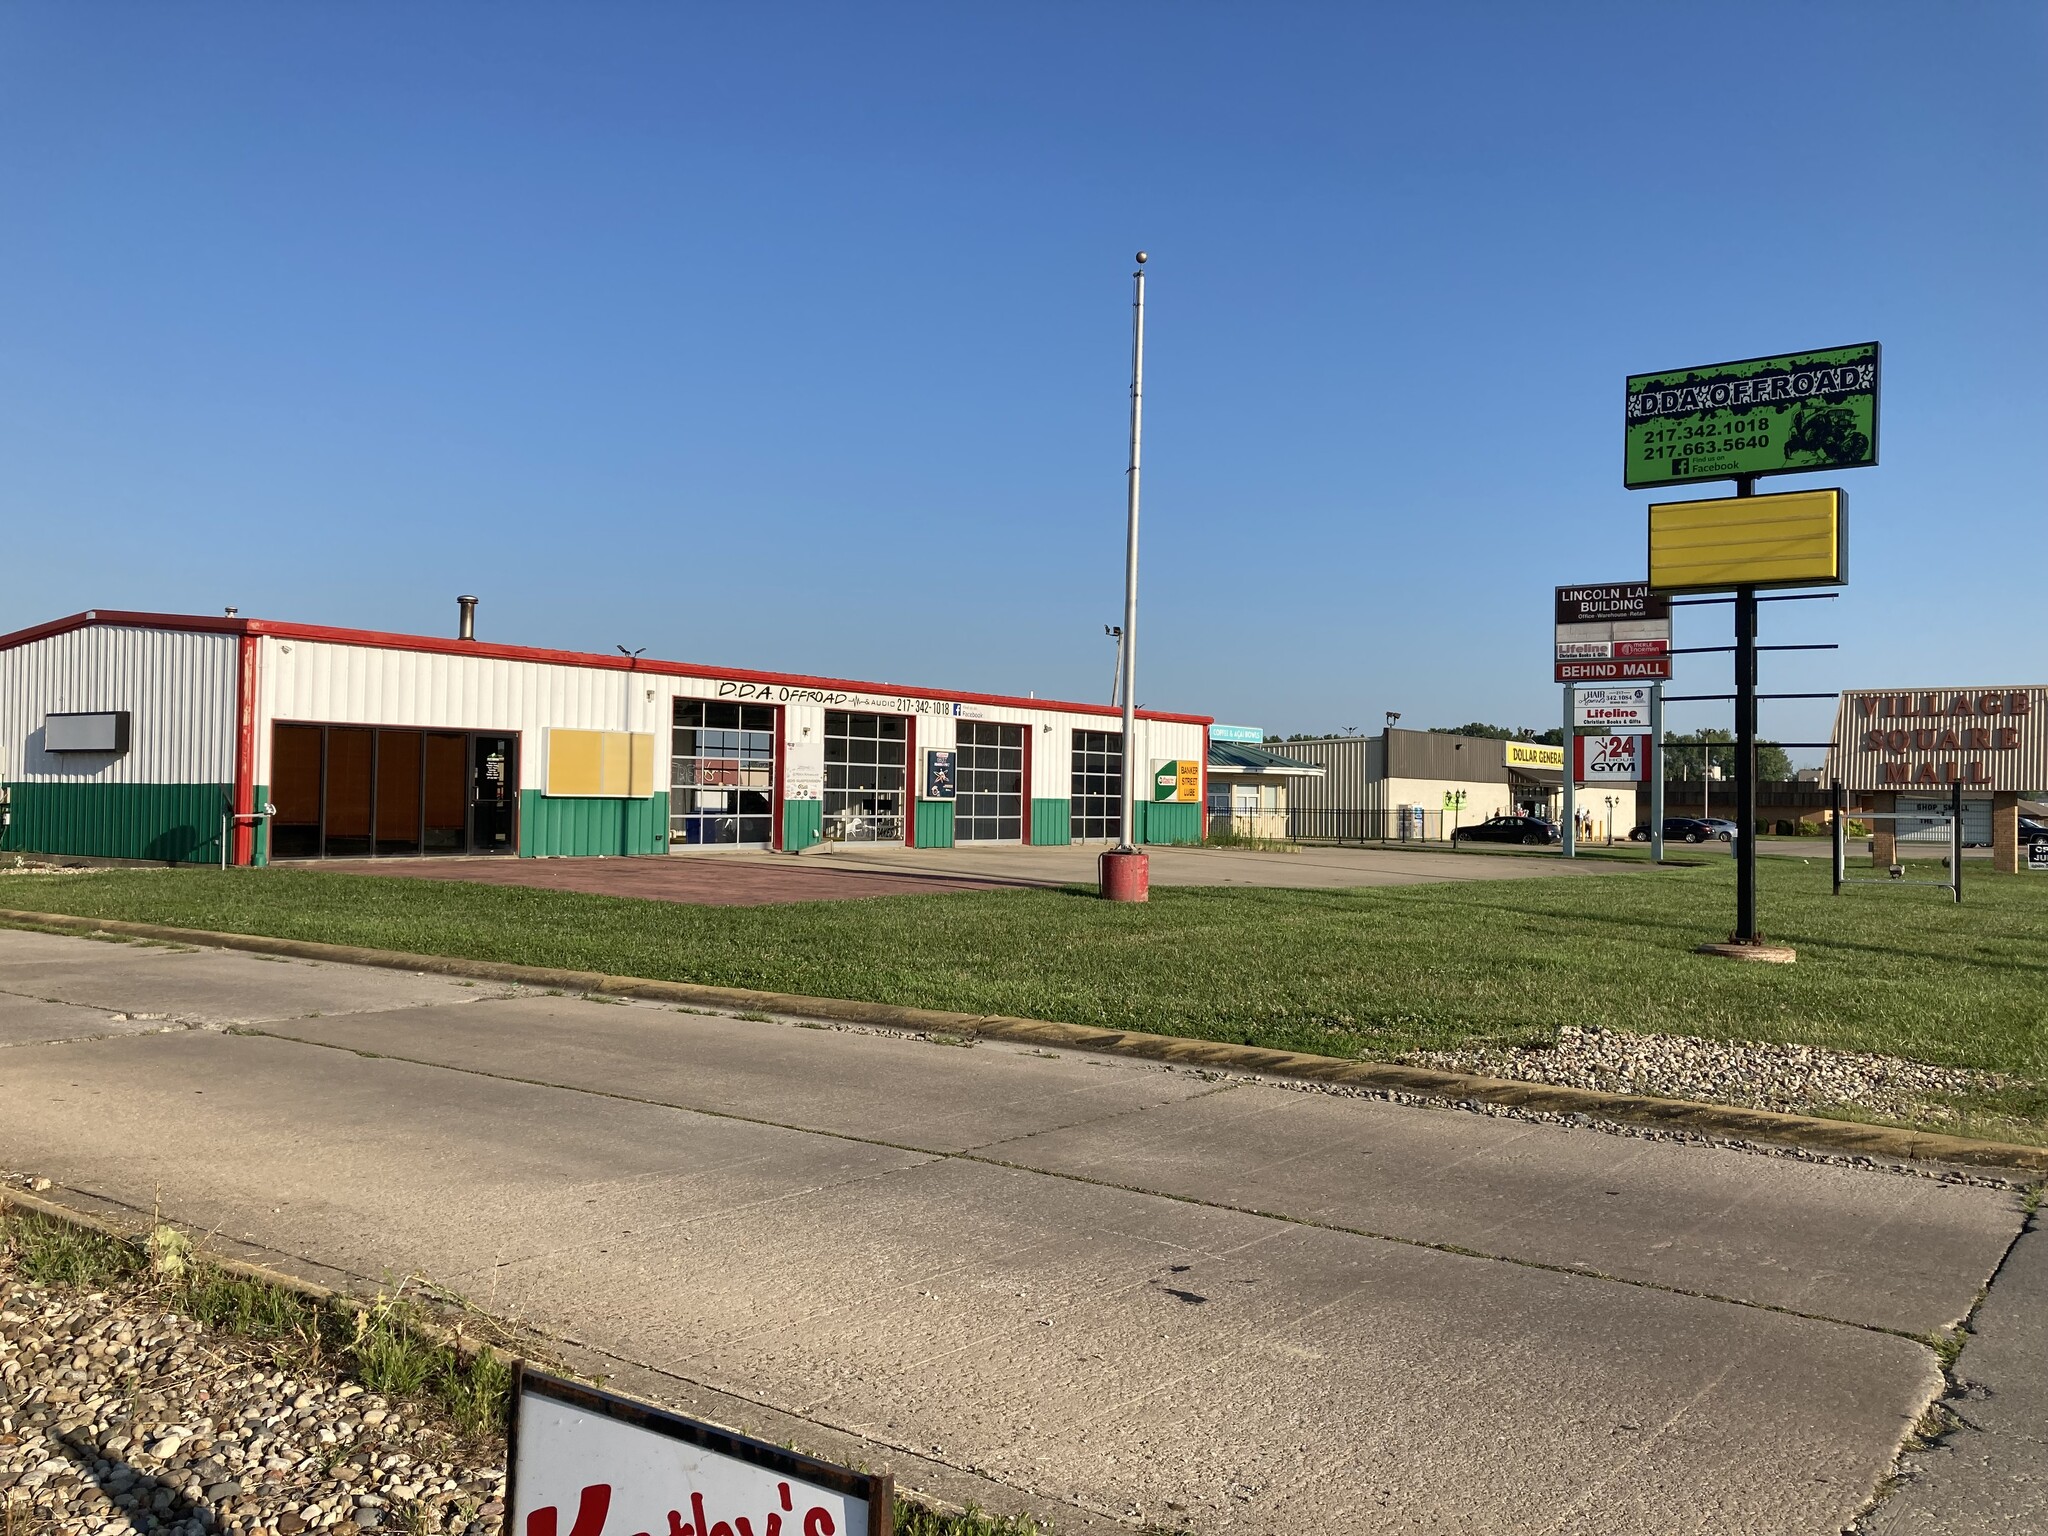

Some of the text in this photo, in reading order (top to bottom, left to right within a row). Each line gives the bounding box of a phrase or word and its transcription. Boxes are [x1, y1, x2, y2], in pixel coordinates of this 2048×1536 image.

[1640, 366, 1861, 416] DDA OFFROAD
[1643, 418, 1770, 444] 217.342.1018
[1643, 434, 1769, 461] 217.663.5640
[1692, 461, 1740, 473] Facebook
[1562, 588, 1620, 602] LINCOLN
[1580, 599, 1644, 612] BUILDING
[1558, 644, 1608, 654] Lifeline
[1562, 663, 1664, 677] BEHIND MALL
[718, 682, 847, 705] D.D.A. OFFROAD
[871, 700, 896, 708] AUDIO
[896, 698, 950, 716] 217-342-1018
[1860, 692, 2032, 718] VILLAGE
[1587, 709, 1638, 718] Lifeline
[1609, 736, 1635, 757] 24
[1867, 727, 2021, 754] SQUARE
[1513, 748, 1564, 764] DOLLAR GENERAL
[1590, 763, 1635, 772] GYM
[1884, 762, 1992, 784] MALL
